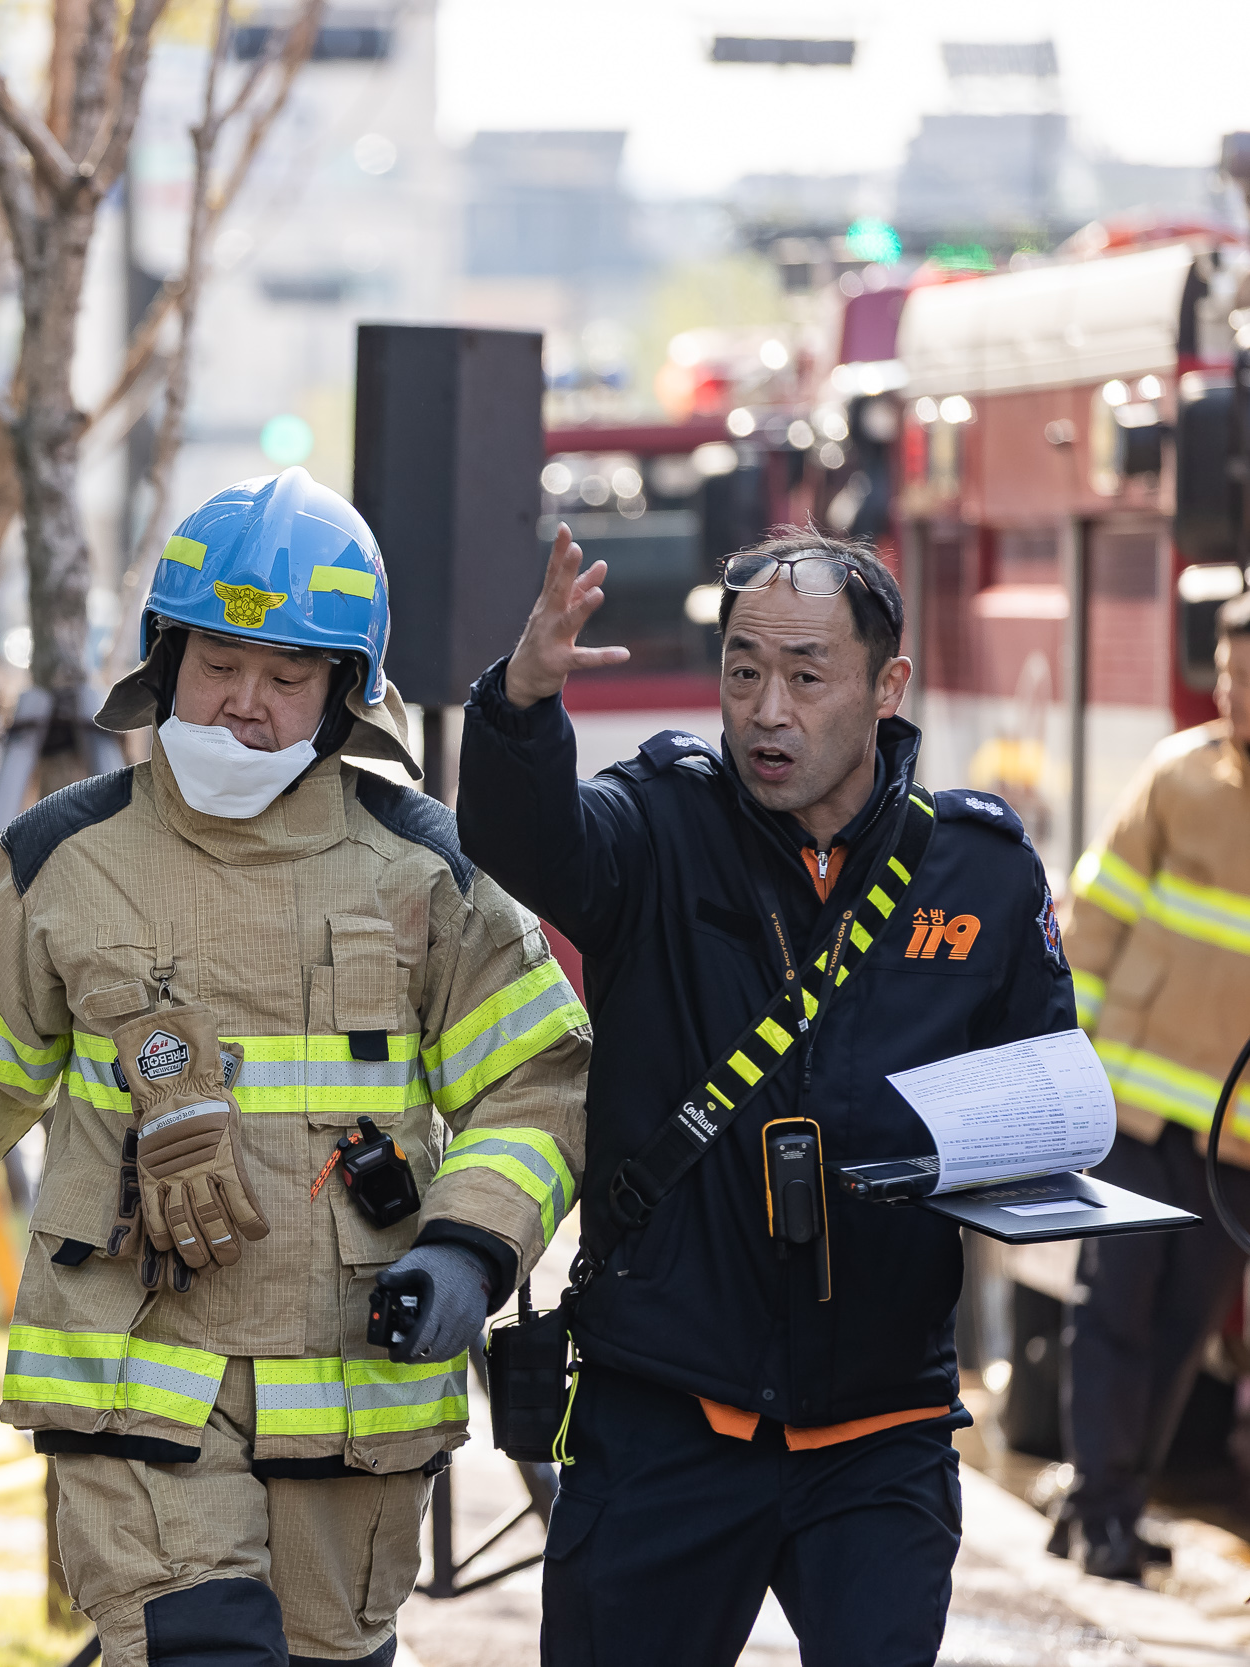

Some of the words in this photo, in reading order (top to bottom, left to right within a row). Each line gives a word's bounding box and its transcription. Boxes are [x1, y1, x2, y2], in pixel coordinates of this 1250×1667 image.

[912, 908, 945, 925] 소방
[771, 912, 790, 967] MOTOROLA
[828, 921, 847, 977] MOTOROLA
[904, 914, 981, 960] 119
[150, 1039, 169, 1054] 119
[682, 1101, 718, 1136] Courant
